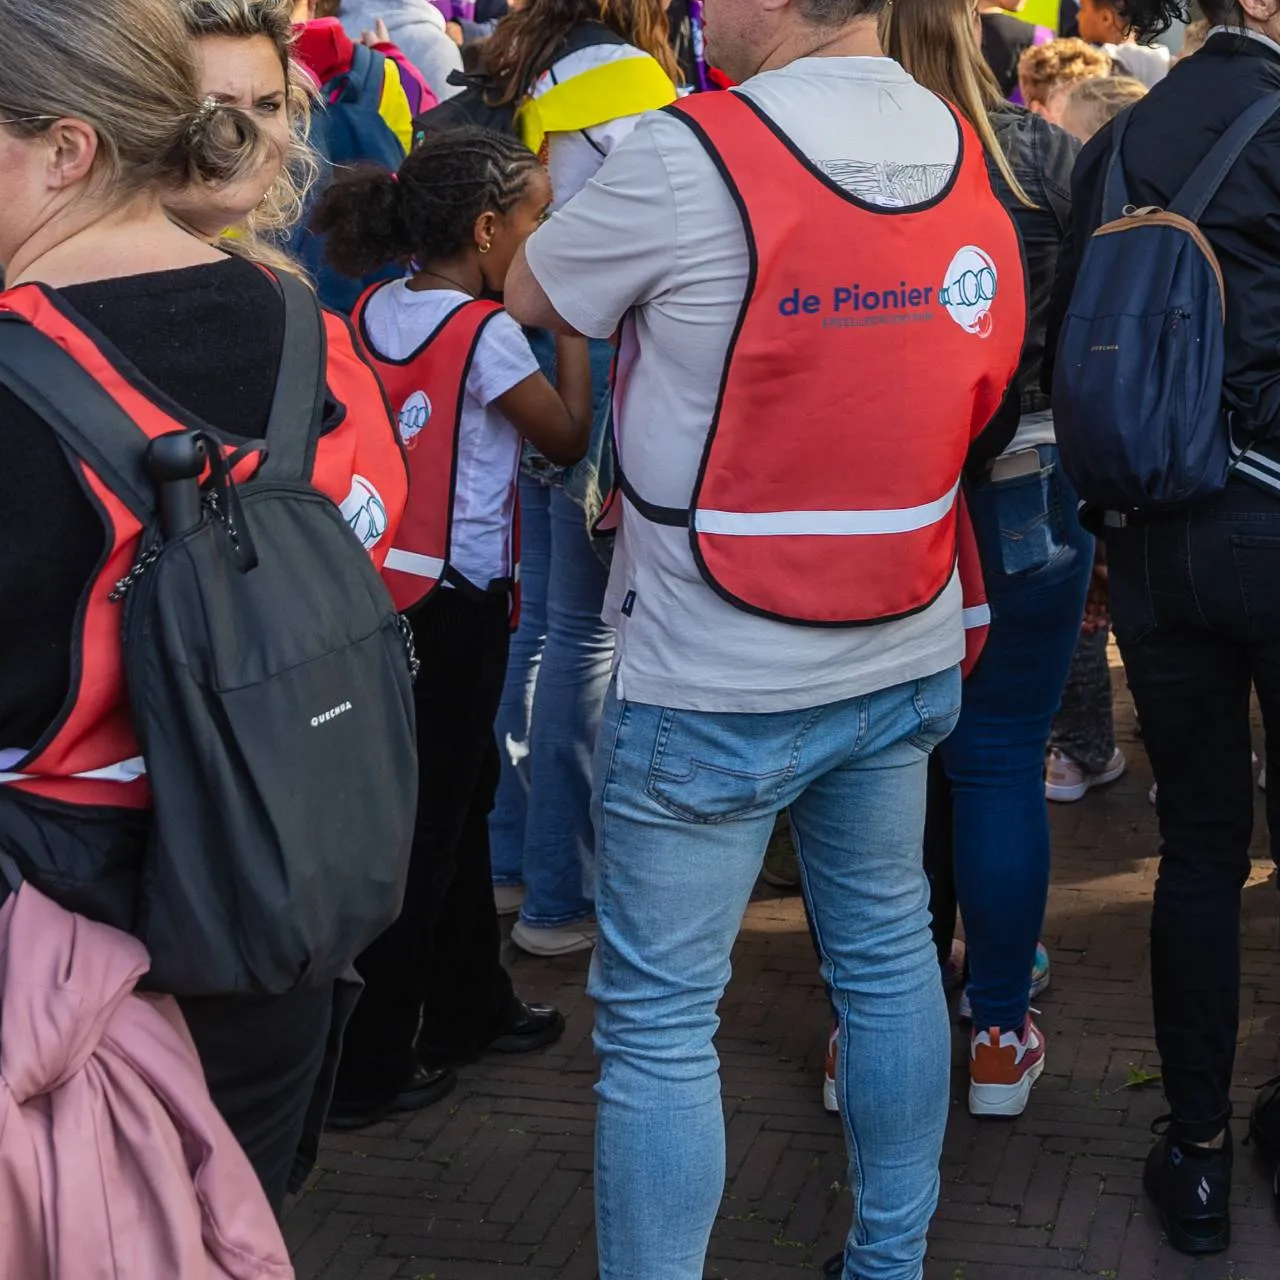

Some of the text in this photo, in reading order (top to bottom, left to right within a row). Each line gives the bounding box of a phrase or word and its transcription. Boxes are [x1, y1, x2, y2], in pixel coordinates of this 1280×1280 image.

[778, 281, 933, 317] de Pionier
[310, 700, 352, 727] QUECHUA
